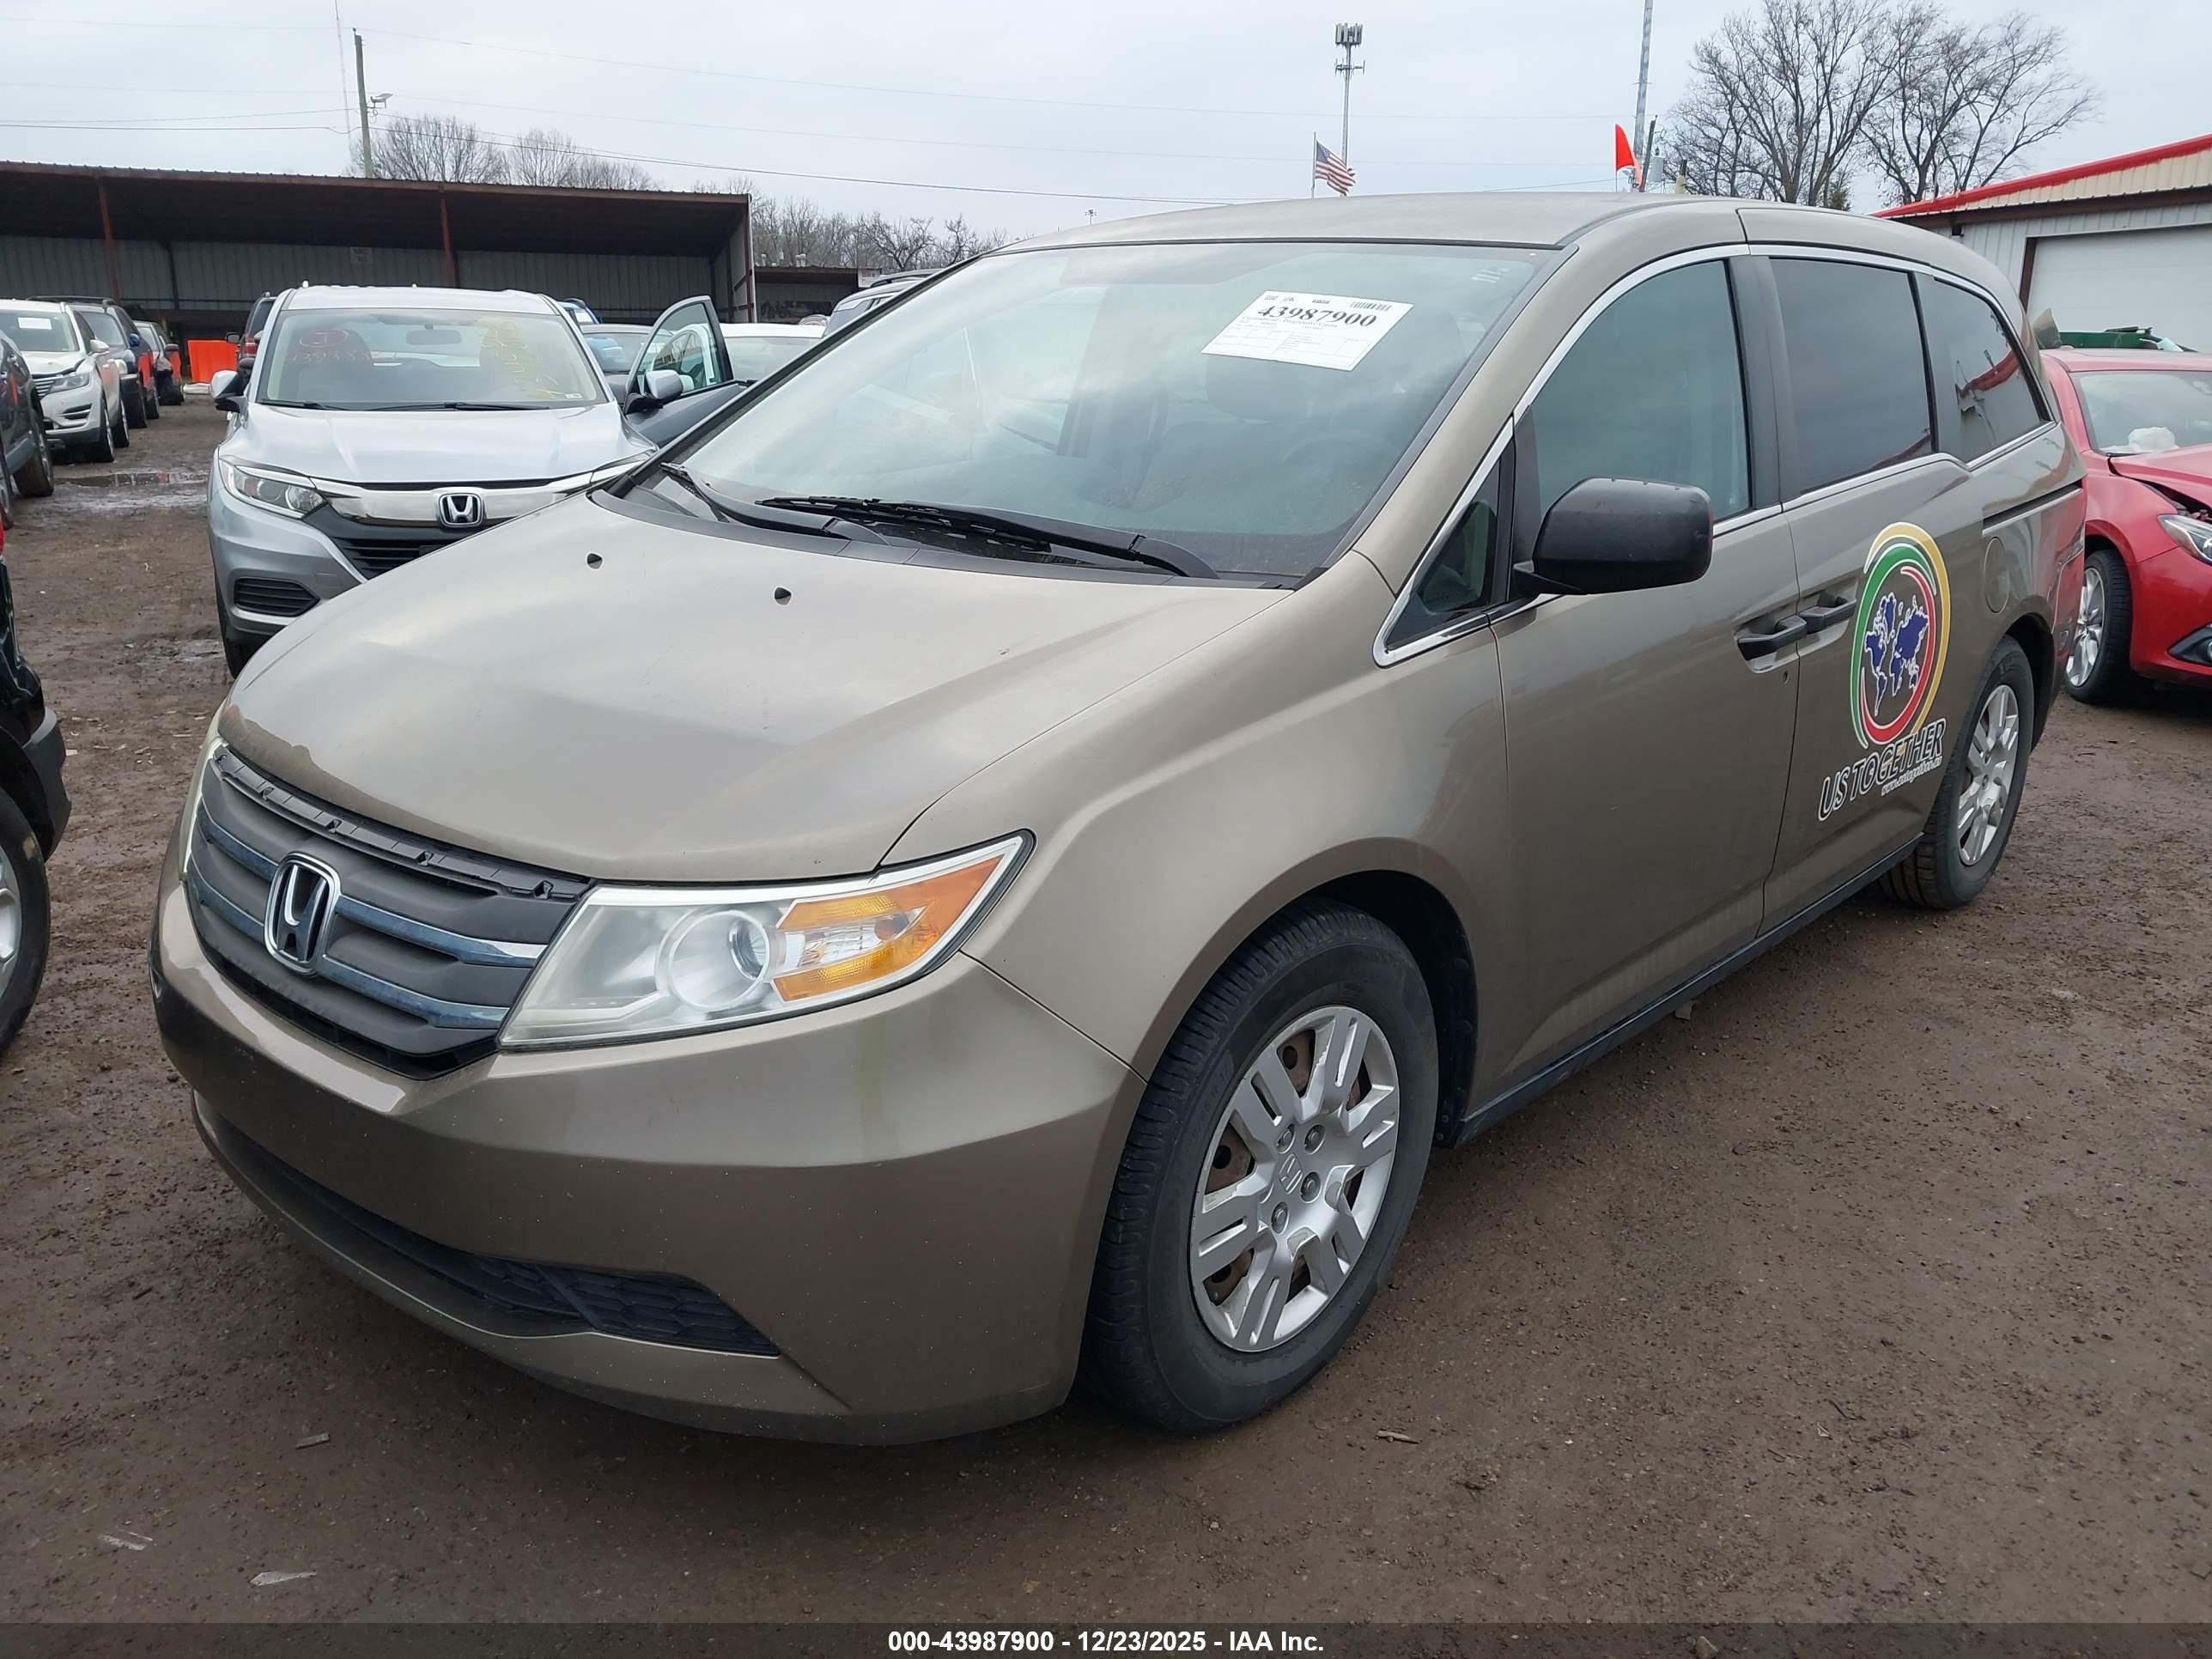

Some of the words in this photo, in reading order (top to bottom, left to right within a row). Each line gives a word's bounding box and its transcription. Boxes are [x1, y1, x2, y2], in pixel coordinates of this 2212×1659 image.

[1257, 305, 1377, 327] 43987900
[1818, 767, 1850, 821] US
[1850, 718, 1946, 801] TOGETHER
